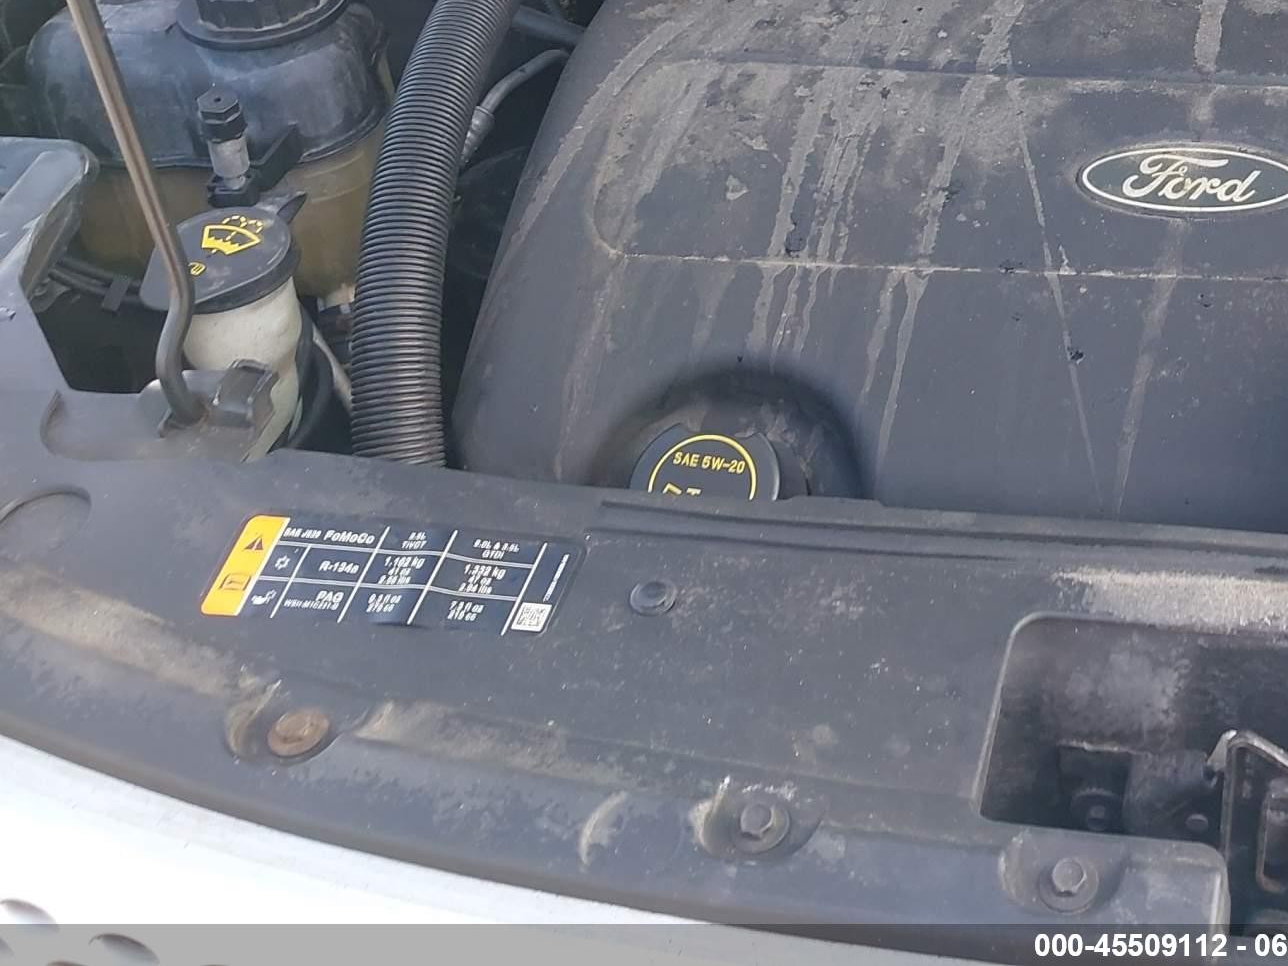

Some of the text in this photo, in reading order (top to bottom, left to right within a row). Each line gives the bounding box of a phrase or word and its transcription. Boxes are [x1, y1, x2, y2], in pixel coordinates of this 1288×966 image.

[1122, 154, 1261, 202] Ford
[672, 451, 699, 468] SAE
[323, 530, 375, 544] FoMoCo
